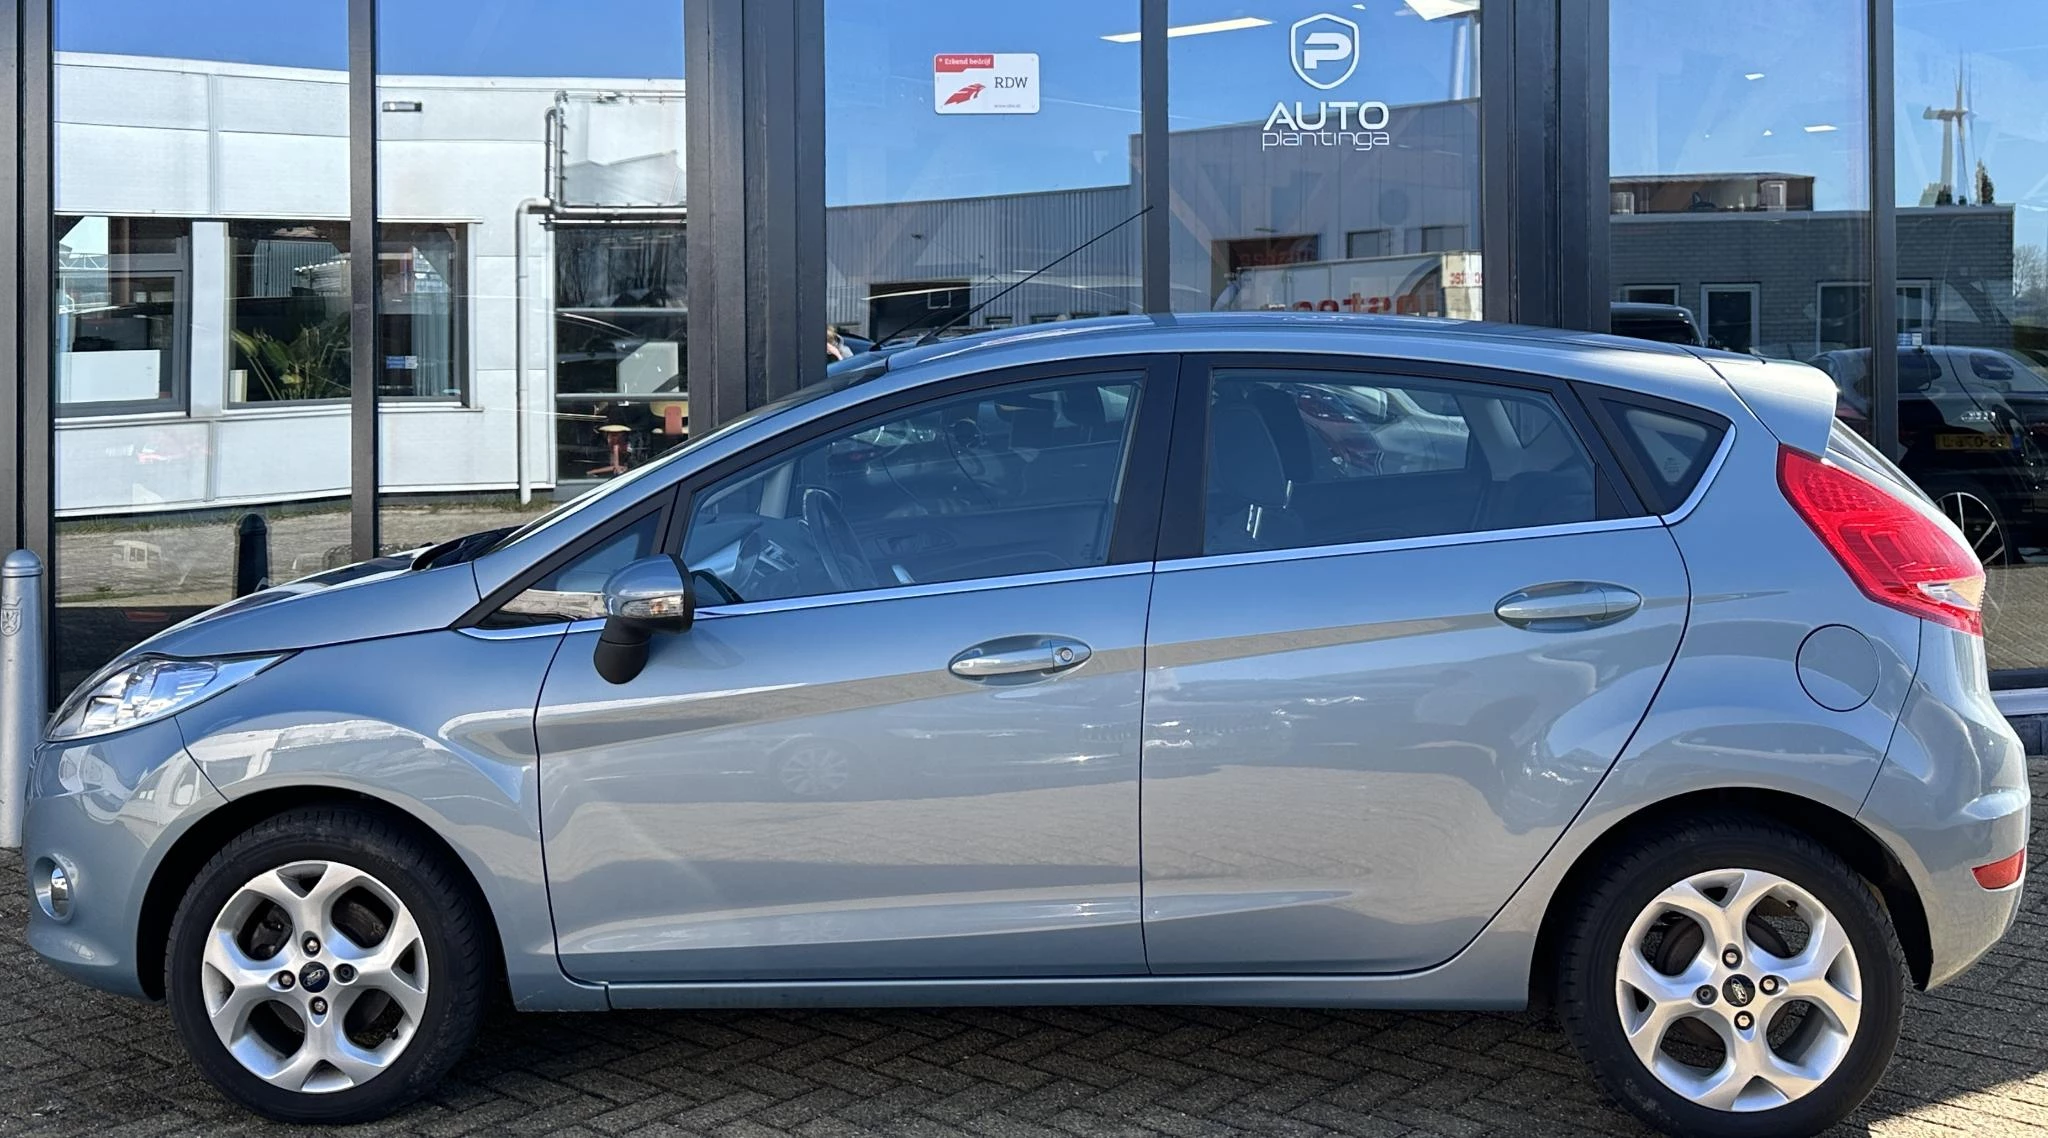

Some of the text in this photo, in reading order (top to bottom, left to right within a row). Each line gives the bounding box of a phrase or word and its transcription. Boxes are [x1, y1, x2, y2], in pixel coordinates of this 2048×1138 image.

[1303, 32, 1353, 69] P
[994, 76, 1028, 88] RDW
[1263, 101, 1390, 131] AUTO
[1262, 128, 1390, 152] plantinga
